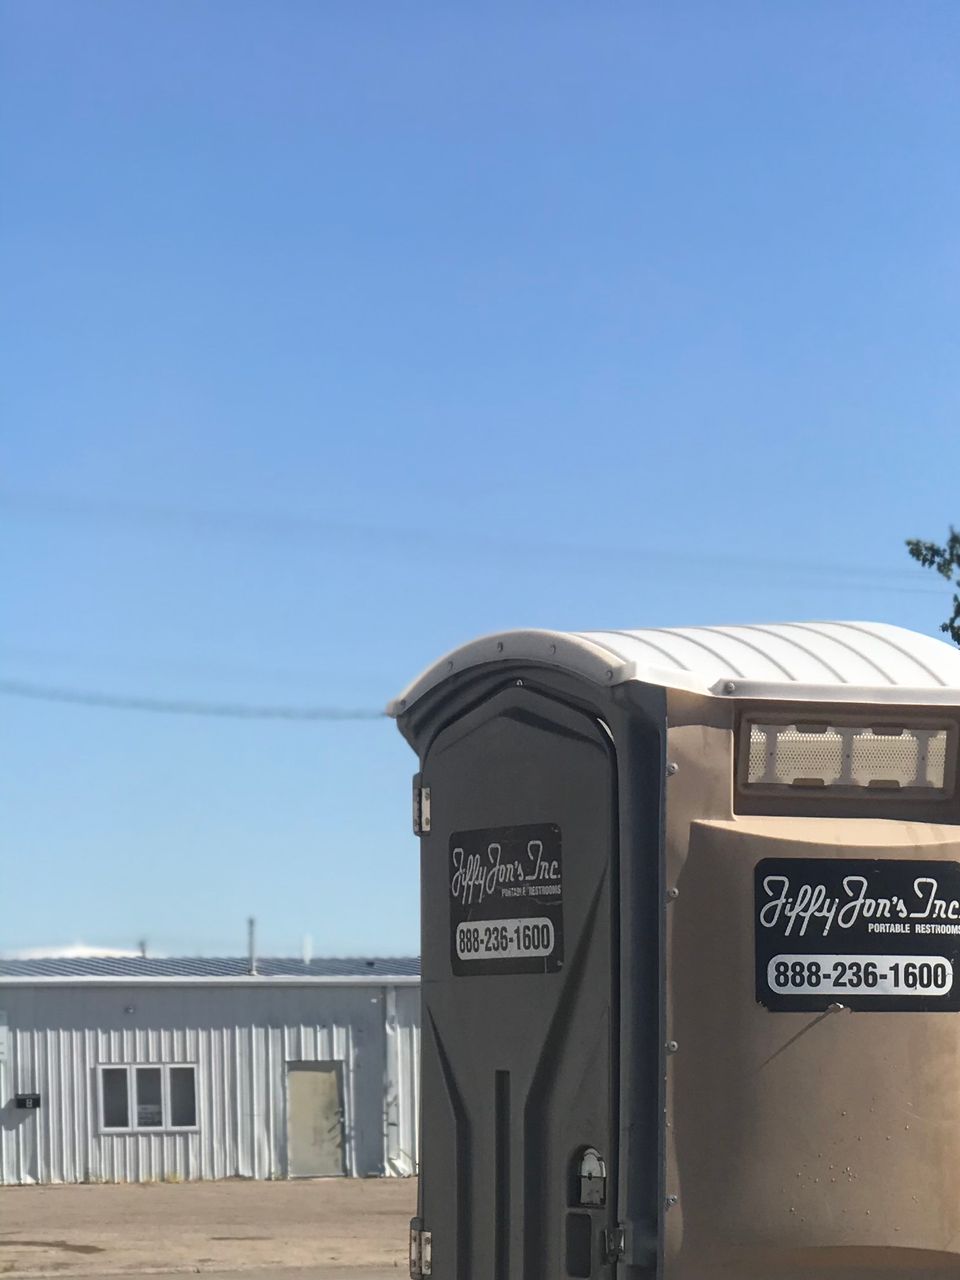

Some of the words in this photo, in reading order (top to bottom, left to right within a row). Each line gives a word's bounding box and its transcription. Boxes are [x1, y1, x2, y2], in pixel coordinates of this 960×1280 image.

[452, 848, 487, 904] Jiffy
[486, 843, 524, 894] Jon's
[525, 840, 561, 881] Inc.
[760, 876, 839, 936] Jiffy
[838, 876, 908, 928] Jon's
[459, 924, 550, 953] 888-236-1600
[868, 923, 910, 933] PORTABLE
[774, 961, 946, 989] 888-236-1600
